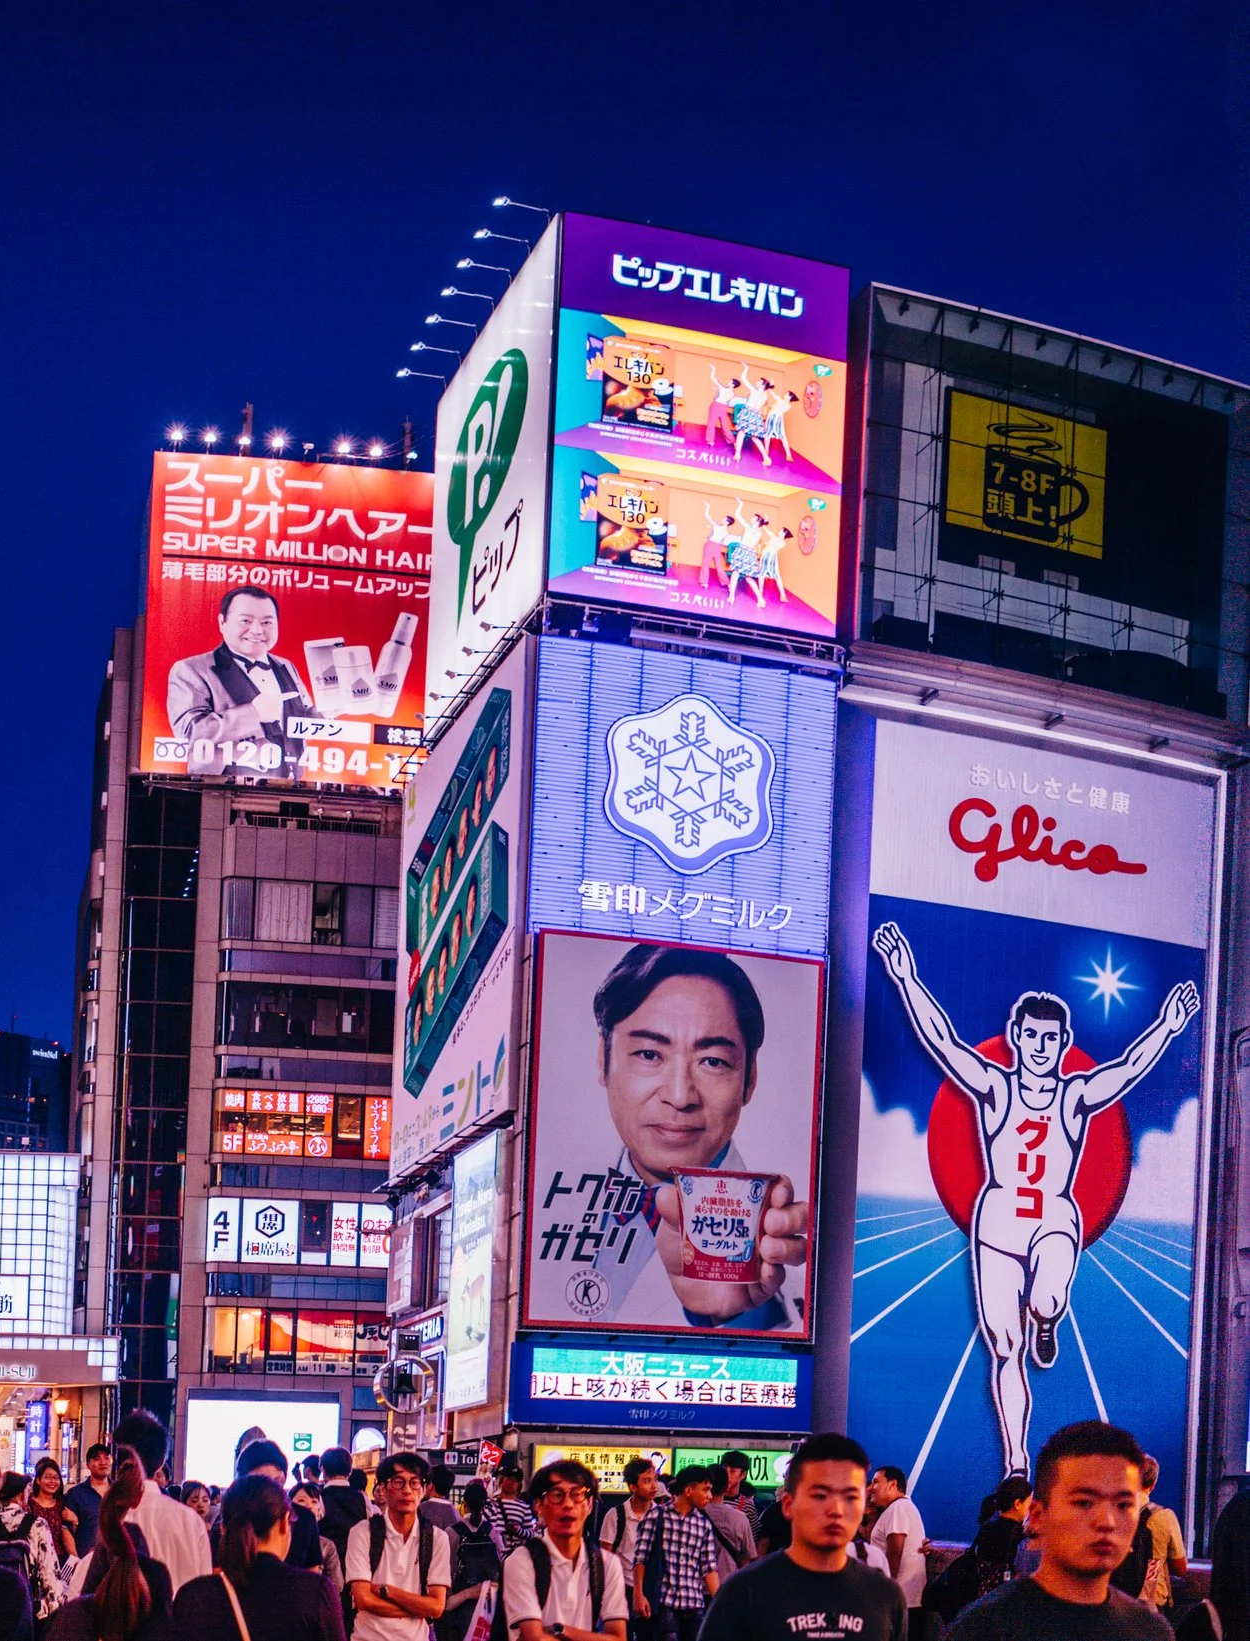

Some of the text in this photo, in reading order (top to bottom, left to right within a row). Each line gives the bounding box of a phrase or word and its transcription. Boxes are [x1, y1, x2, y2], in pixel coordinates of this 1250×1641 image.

[612, 253, 804, 318] ピップエレキバン
[613, 356, 666, 376] エレキバン
[627, 372, 652, 385] 130
[164, 460, 324, 499] スーパー
[991, 461, 1056, 496] 7-8F
[607, 494, 659, 514] エレキバン
[164, 495, 434, 541] ミリオンヘアー
[621, 511, 646, 525] 130
[162, 531, 256, 556] SUPER
[265, 539, 367, 565] MILLION
[472, 498, 524, 616] ピップ
[292, 721, 343, 737] ルアン
[968, 763, 1131, 816] おいしさと健康
[578, 880, 793, 931] 雪印メグミルク
[224, 1092, 245, 1108] 焼肉
[251, 1090, 299, 1103] 食べ放題
[222, 1134, 244, 1151] 5F
[1015, 1114, 1052, 1221] グリコ
[543, 1170, 643, 1213] トクホ
[694, 1205, 752, 1218] 減らすのを助ける
[701, 1196, 743, 1208] 内臓脂肪を
[581, 1213, 598, 1225] の
[691, 1215, 736, 1237] ガセリ
[539, 1222, 638, 1264] ガセリ
[701, 1239, 739, 1251] ヨーグルト
[267, 1362, 294, 1373] 営業時間
[601, 1351, 731, 1380] 大阪ニュース
[628, 1408, 696, 1421] 雪印メグミルク
[786, 1612, 827, 1632] TREK
